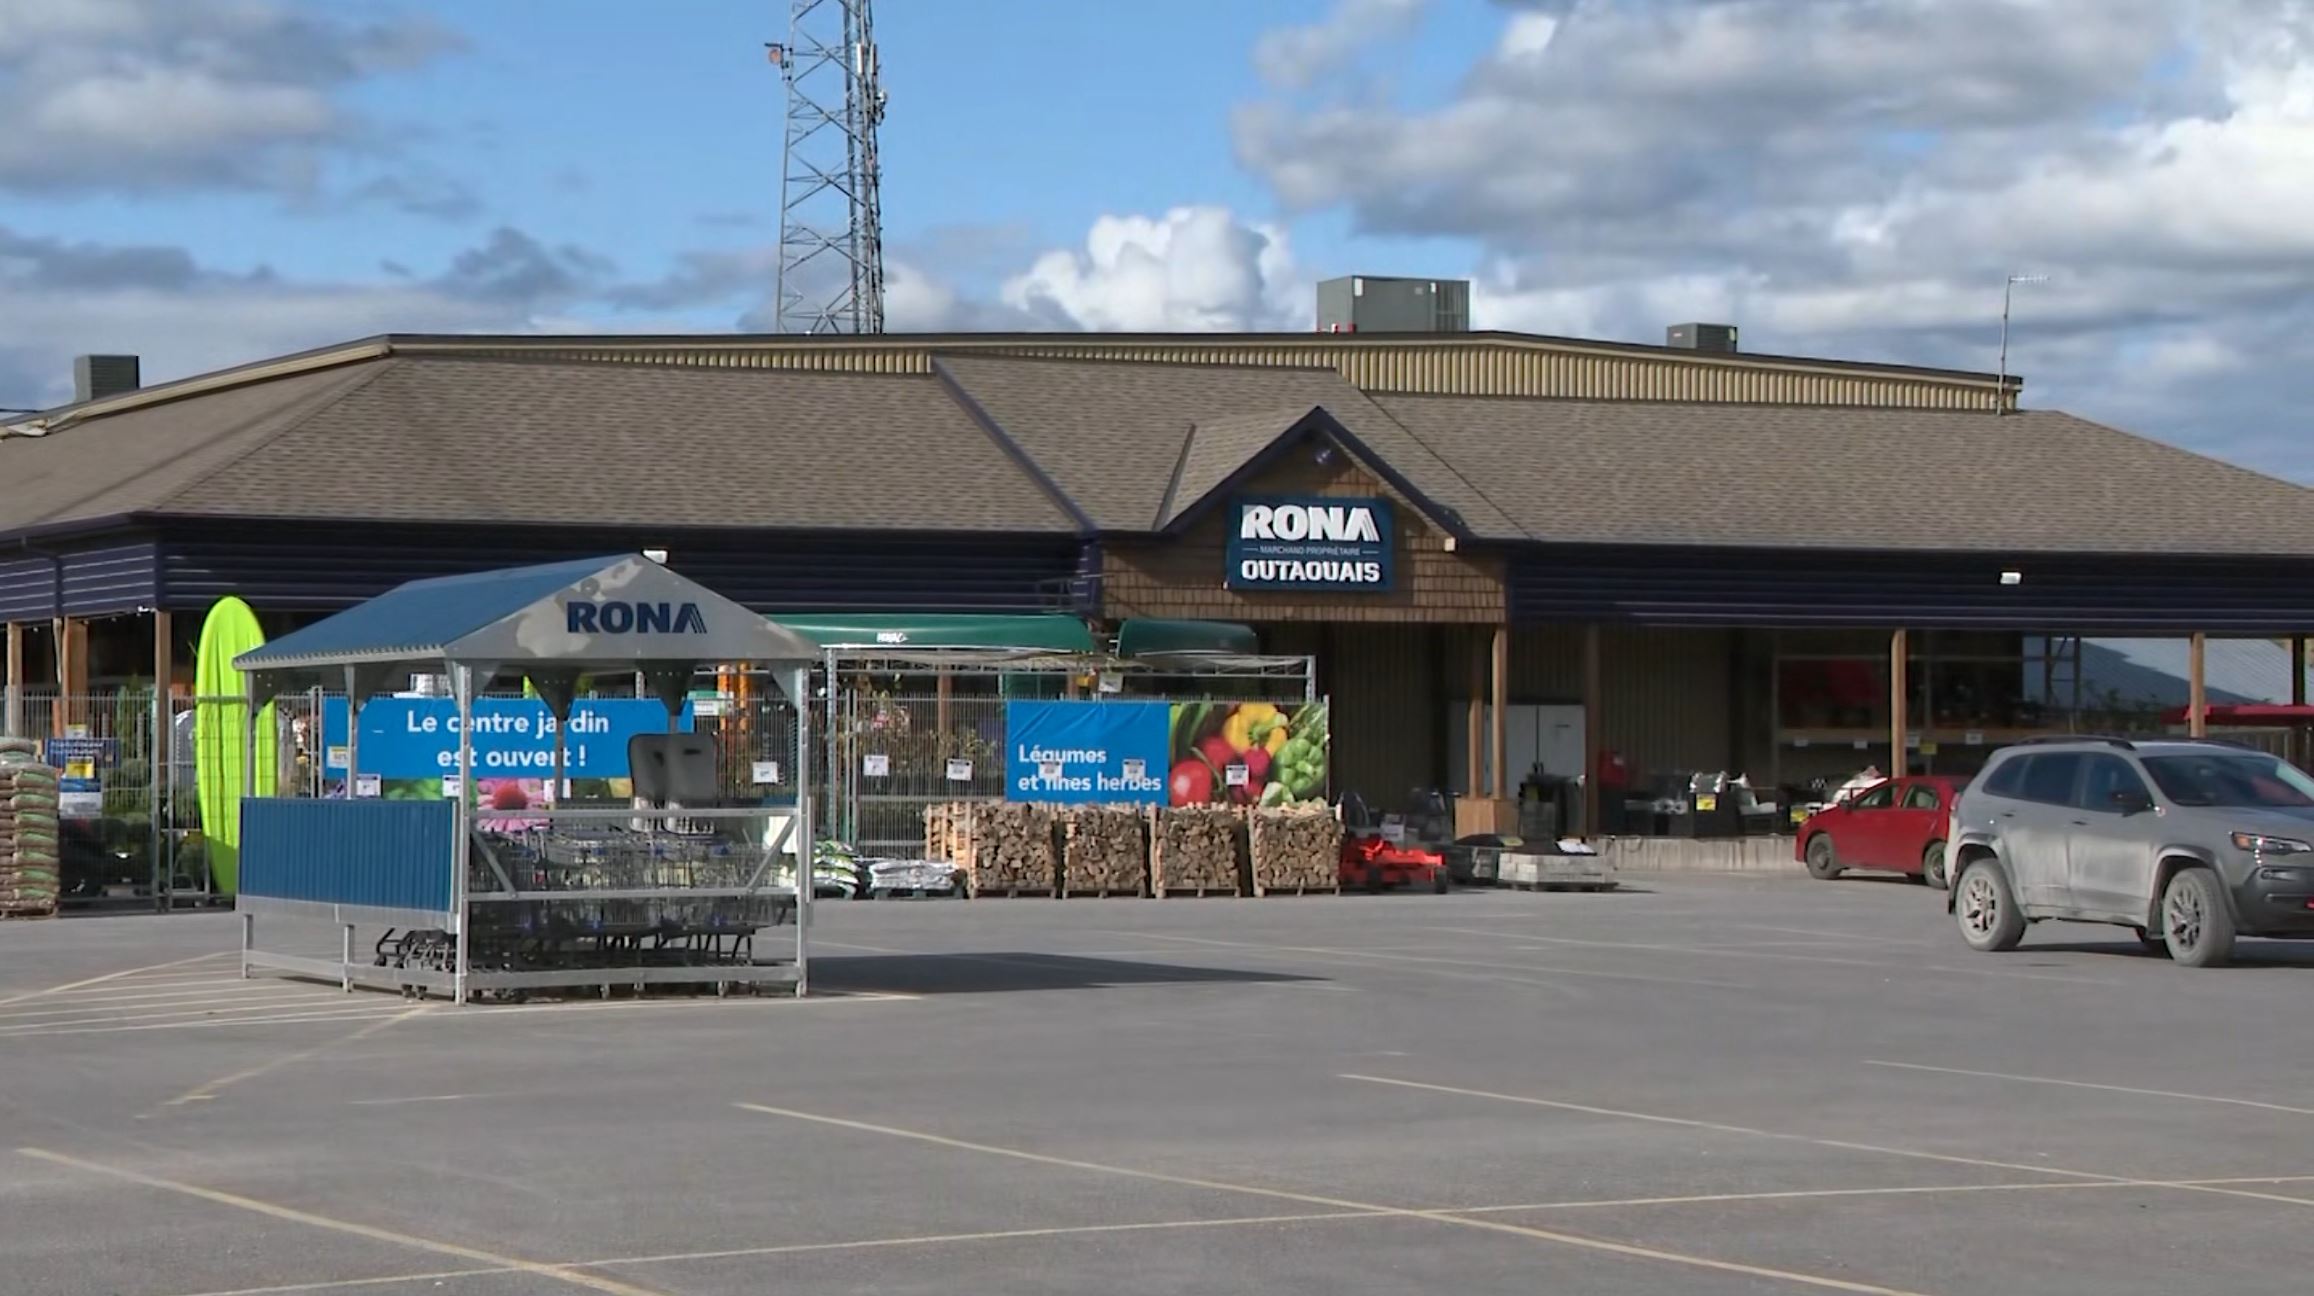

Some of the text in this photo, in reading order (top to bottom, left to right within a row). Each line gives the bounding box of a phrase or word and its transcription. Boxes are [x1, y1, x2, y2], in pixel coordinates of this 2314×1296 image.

[1240, 505, 1380, 542] RONA
[1241, 560, 1381, 583] OUTAOUAIS
[567, 601, 708, 634] RONA
[407, 710, 609, 739] Le cntre jadin
[578, 745, 586, 767] !
[1018, 774, 1040, 791] et
